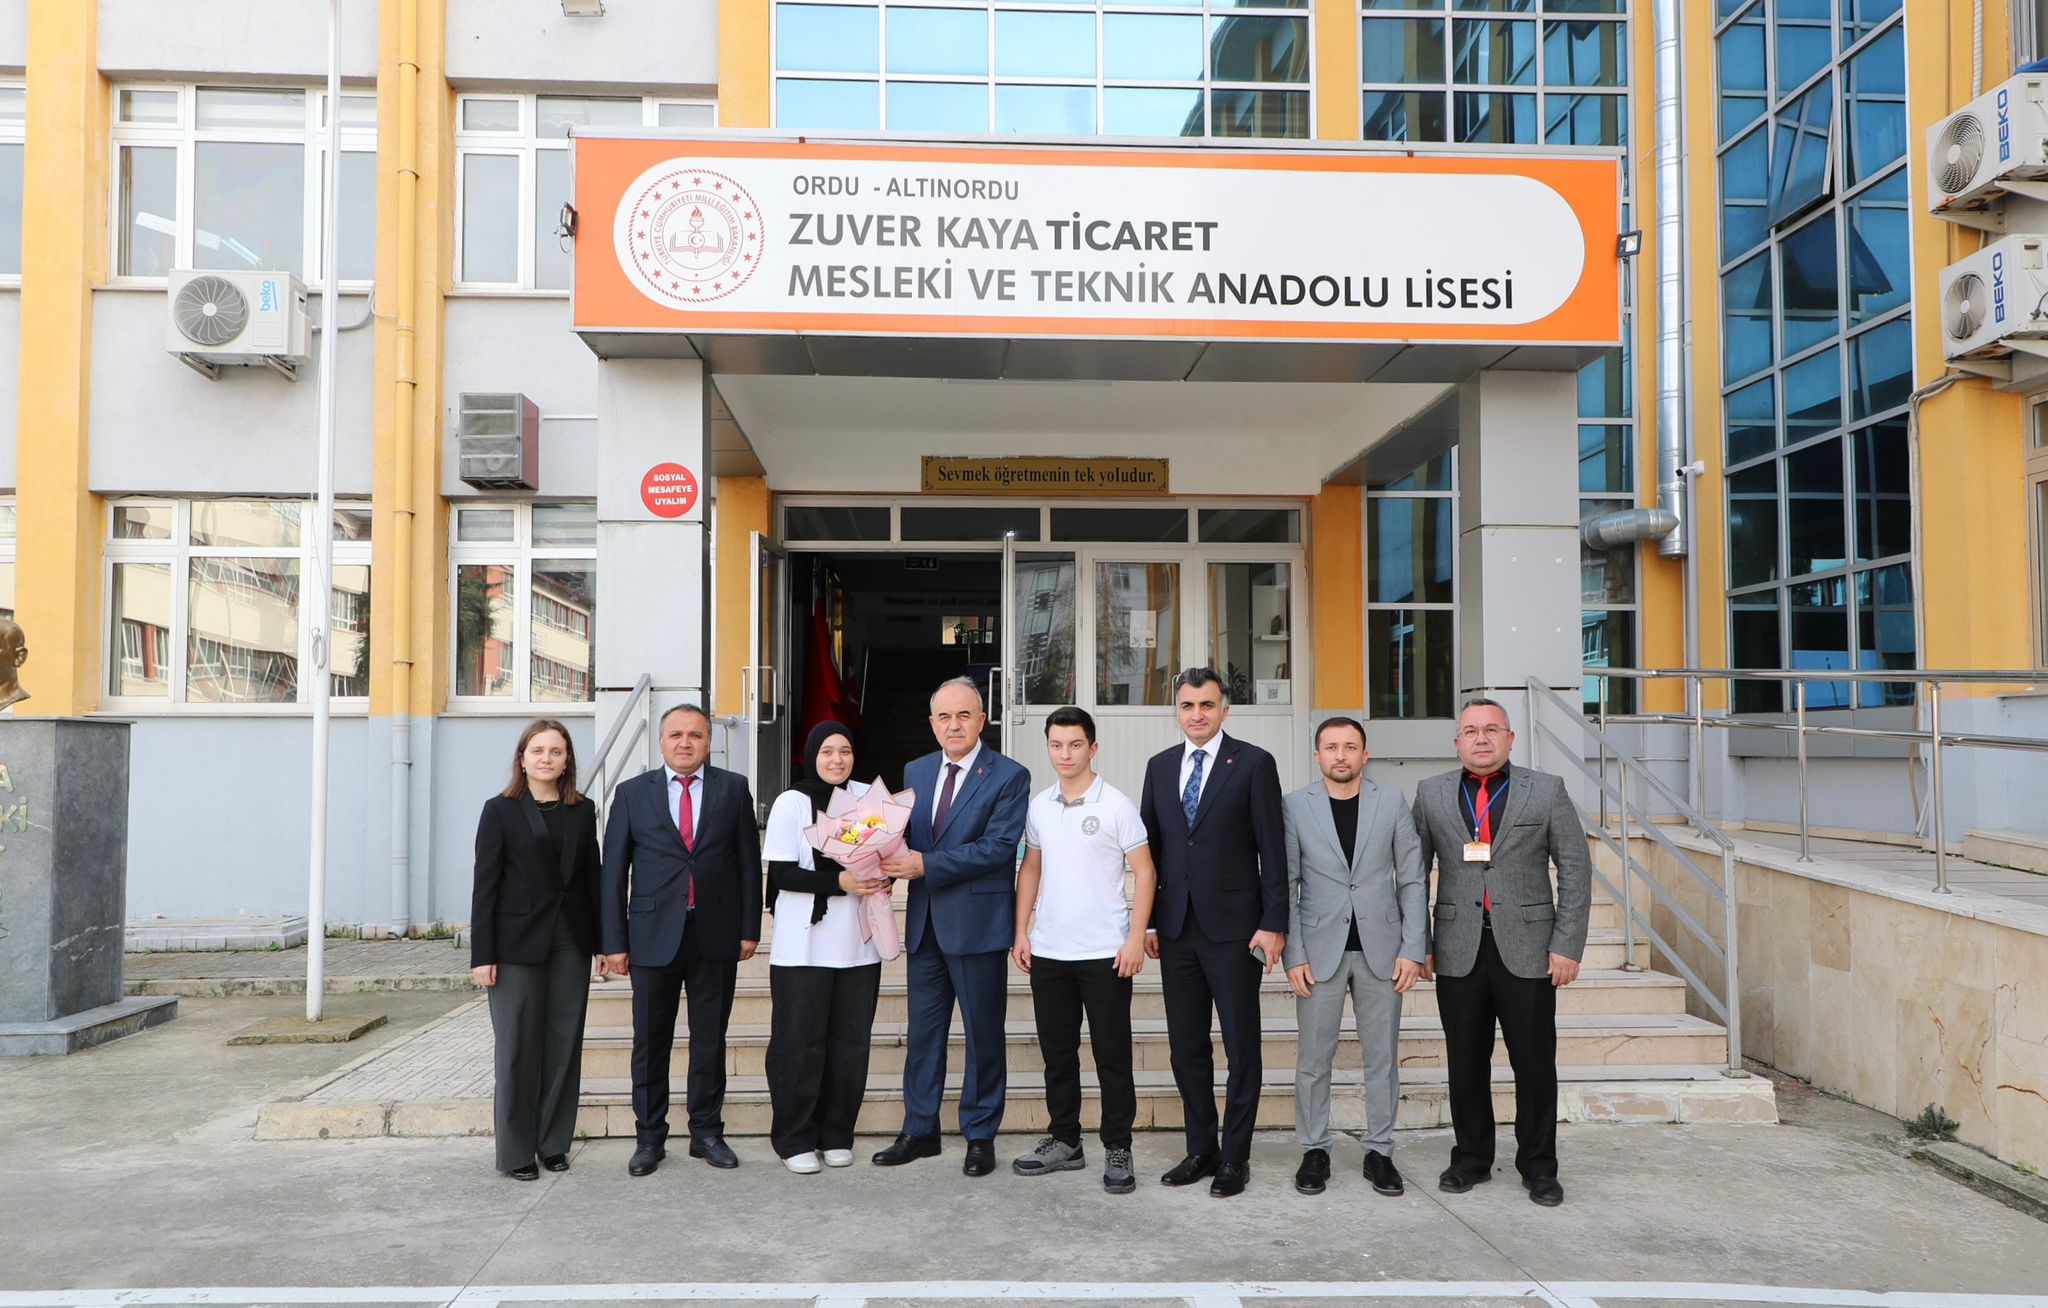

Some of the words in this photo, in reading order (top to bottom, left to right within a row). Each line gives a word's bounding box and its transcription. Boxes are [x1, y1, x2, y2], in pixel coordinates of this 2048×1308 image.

[1998, 88, 2010, 162] BEKO
[792, 175, 859, 196] ORDU
[788, 213, 922, 248] ZUVER
[937, 215, 1040, 250] KAYA
[1046, 211, 1218, 251] TİCARET
[259, 280, 271, 312] beko
[788, 258, 952, 299] MESLEKİ
[967, 268, 1015, 301] VE
[1031, 262, 1175, 303] TEKNİK
[1187, 271, 1389, 308] ANADOLU
[1406, 268, 1513, 310] LİSESİ
[1992, 251, 2005, 324] BEKO
[647, 485, 693, 494] MESAFEYE
[653, 474, 686, 482] SOSYAL
[938, 465, 990, 481] Sevmek
[995, 465, 1070, 486] öğretmenin
[1074, 466, 1095, 482] tek
[1099, 466, 1156, 487] yoludur.
[655, 497, 687, 505] UYALIM
